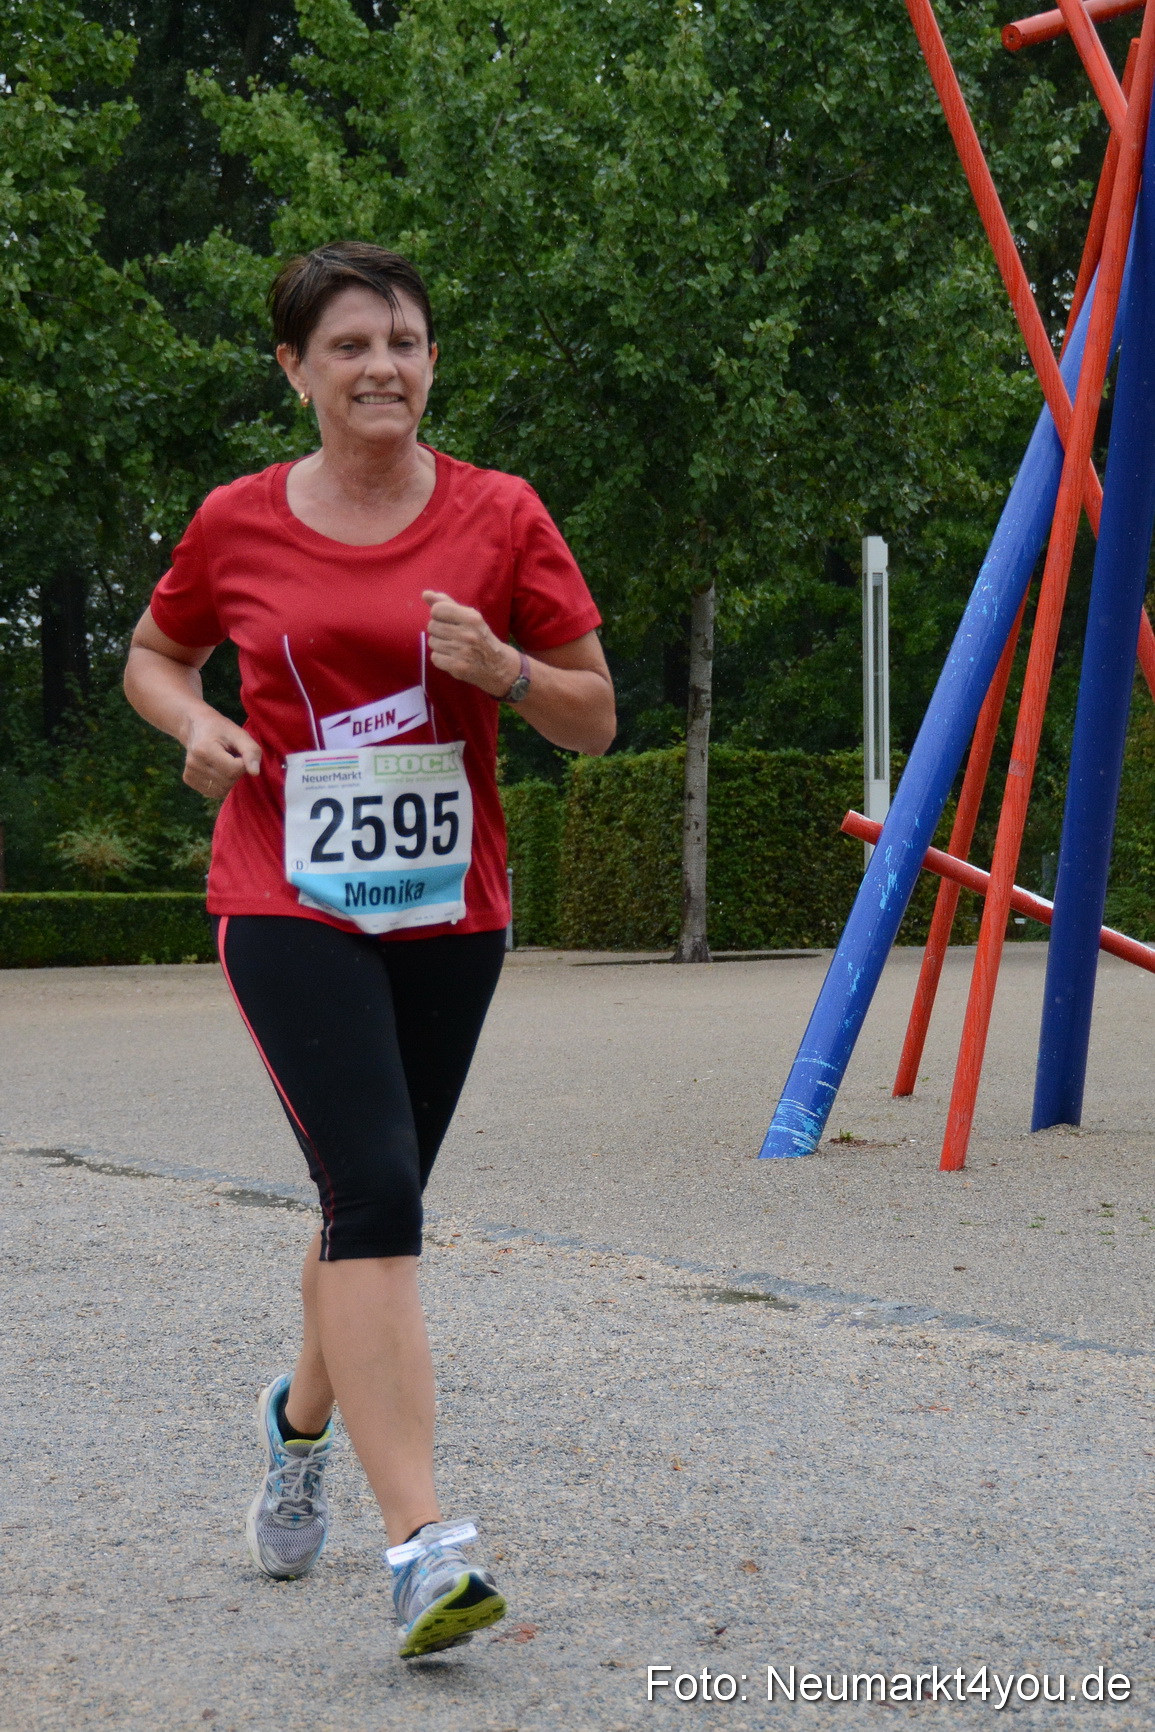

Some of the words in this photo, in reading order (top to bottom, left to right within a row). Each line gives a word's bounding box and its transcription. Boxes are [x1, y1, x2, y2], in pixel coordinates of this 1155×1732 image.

[352, 708, 396, 737] DEHN
[302, 771, 362, 783] NeuerMarkt
[374, 752, 459, 776] BOCK
[309, 790, 460, 863] 2595
[296, 860, 304, 871] D
[344, 879, 426, 907] Monika
